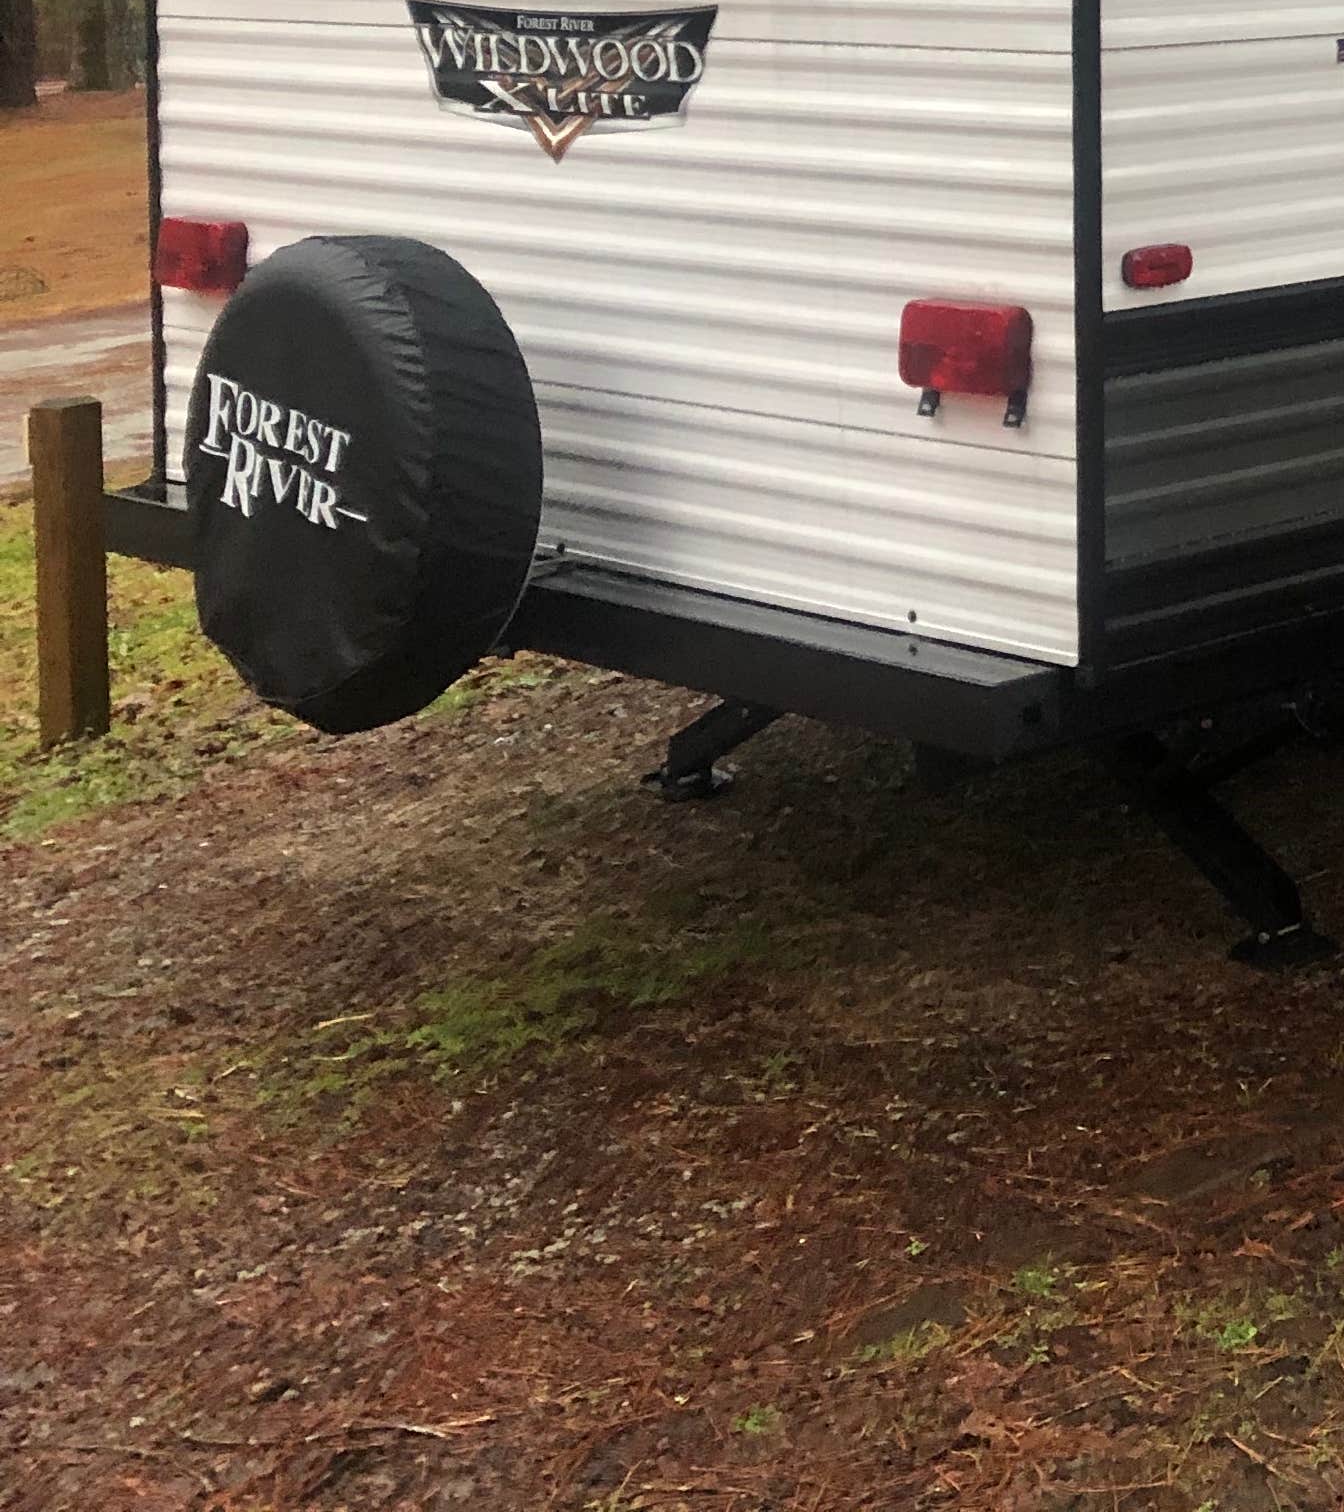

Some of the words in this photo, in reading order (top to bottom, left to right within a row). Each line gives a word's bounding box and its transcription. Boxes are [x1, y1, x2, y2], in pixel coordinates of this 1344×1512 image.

[516, 14, 558, 31] FOREST
[560, 15, 595, 33] RIVER
[420, 26, 703, 83] WILDWOOD
[474, 79, 536, 112] X
[547, 87, 650, 118] LITE
[203, 372, 351, 474] FOREST
[219, 430, 338, 531] RIVER
